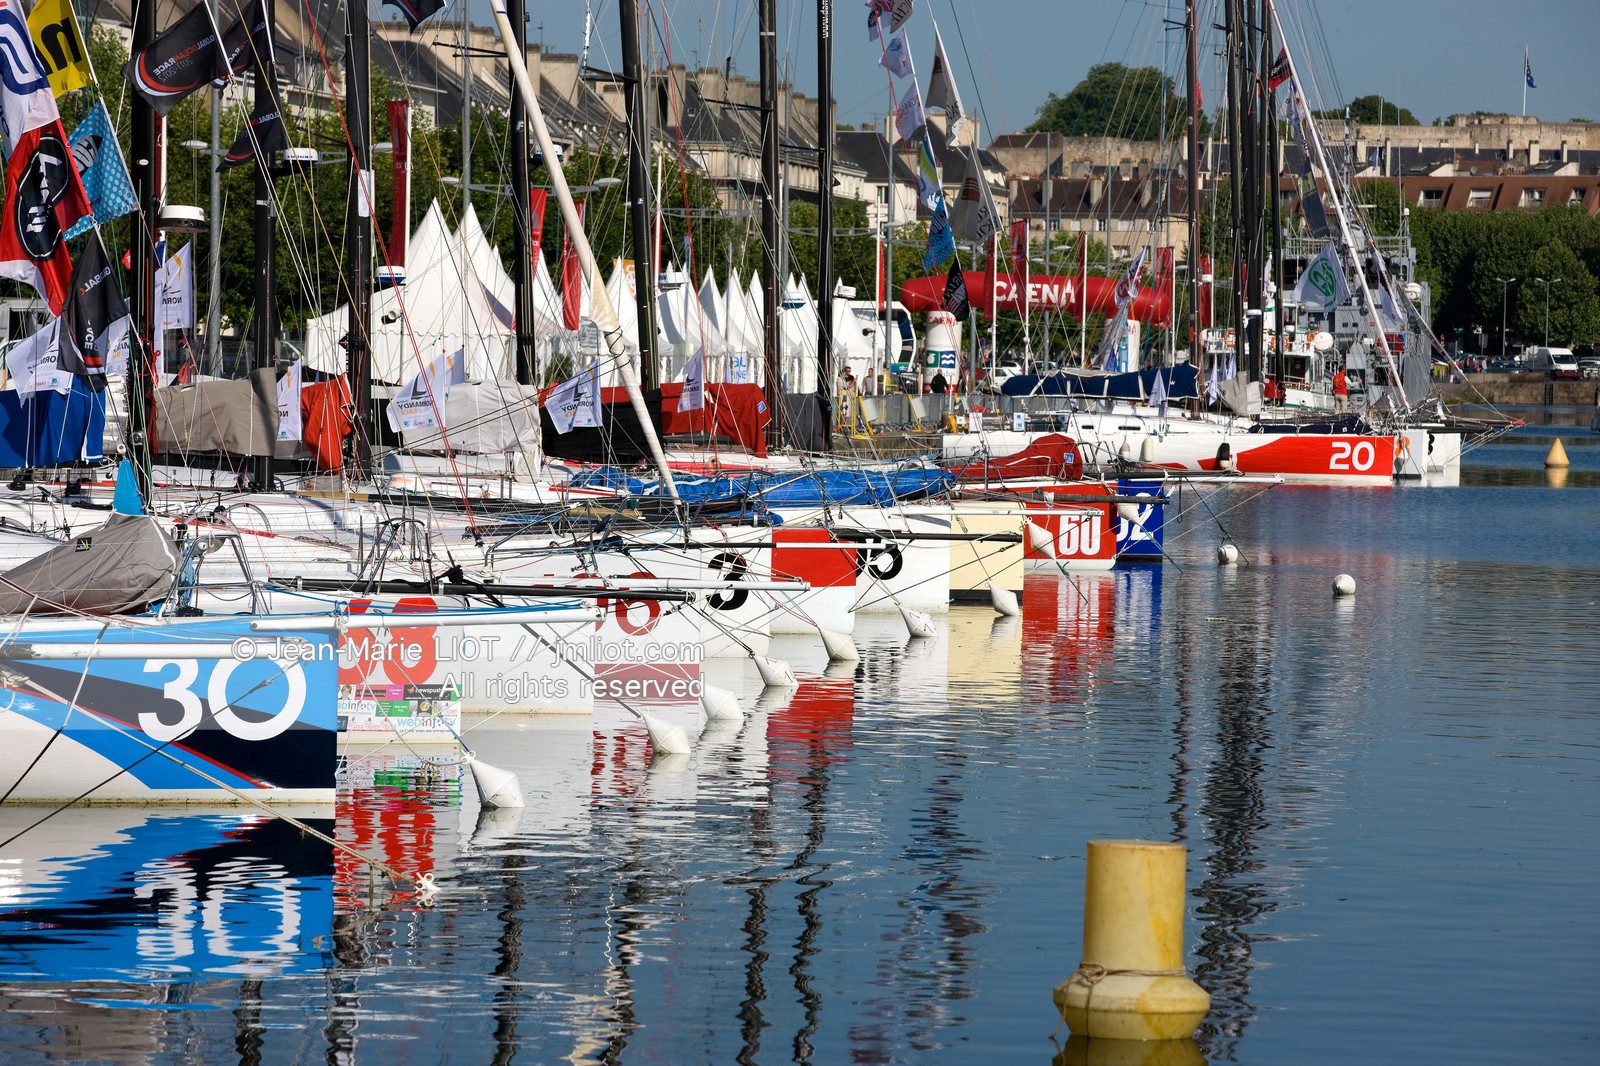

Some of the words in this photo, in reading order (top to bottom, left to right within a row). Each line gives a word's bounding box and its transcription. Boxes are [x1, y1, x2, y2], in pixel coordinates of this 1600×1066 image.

[1329, 441, 1375, 471] 20
[1058, 513, 1101, 556] 60
[138, 657, 307, 742] 30
[338, 701, 376, 713] ebinfotv
